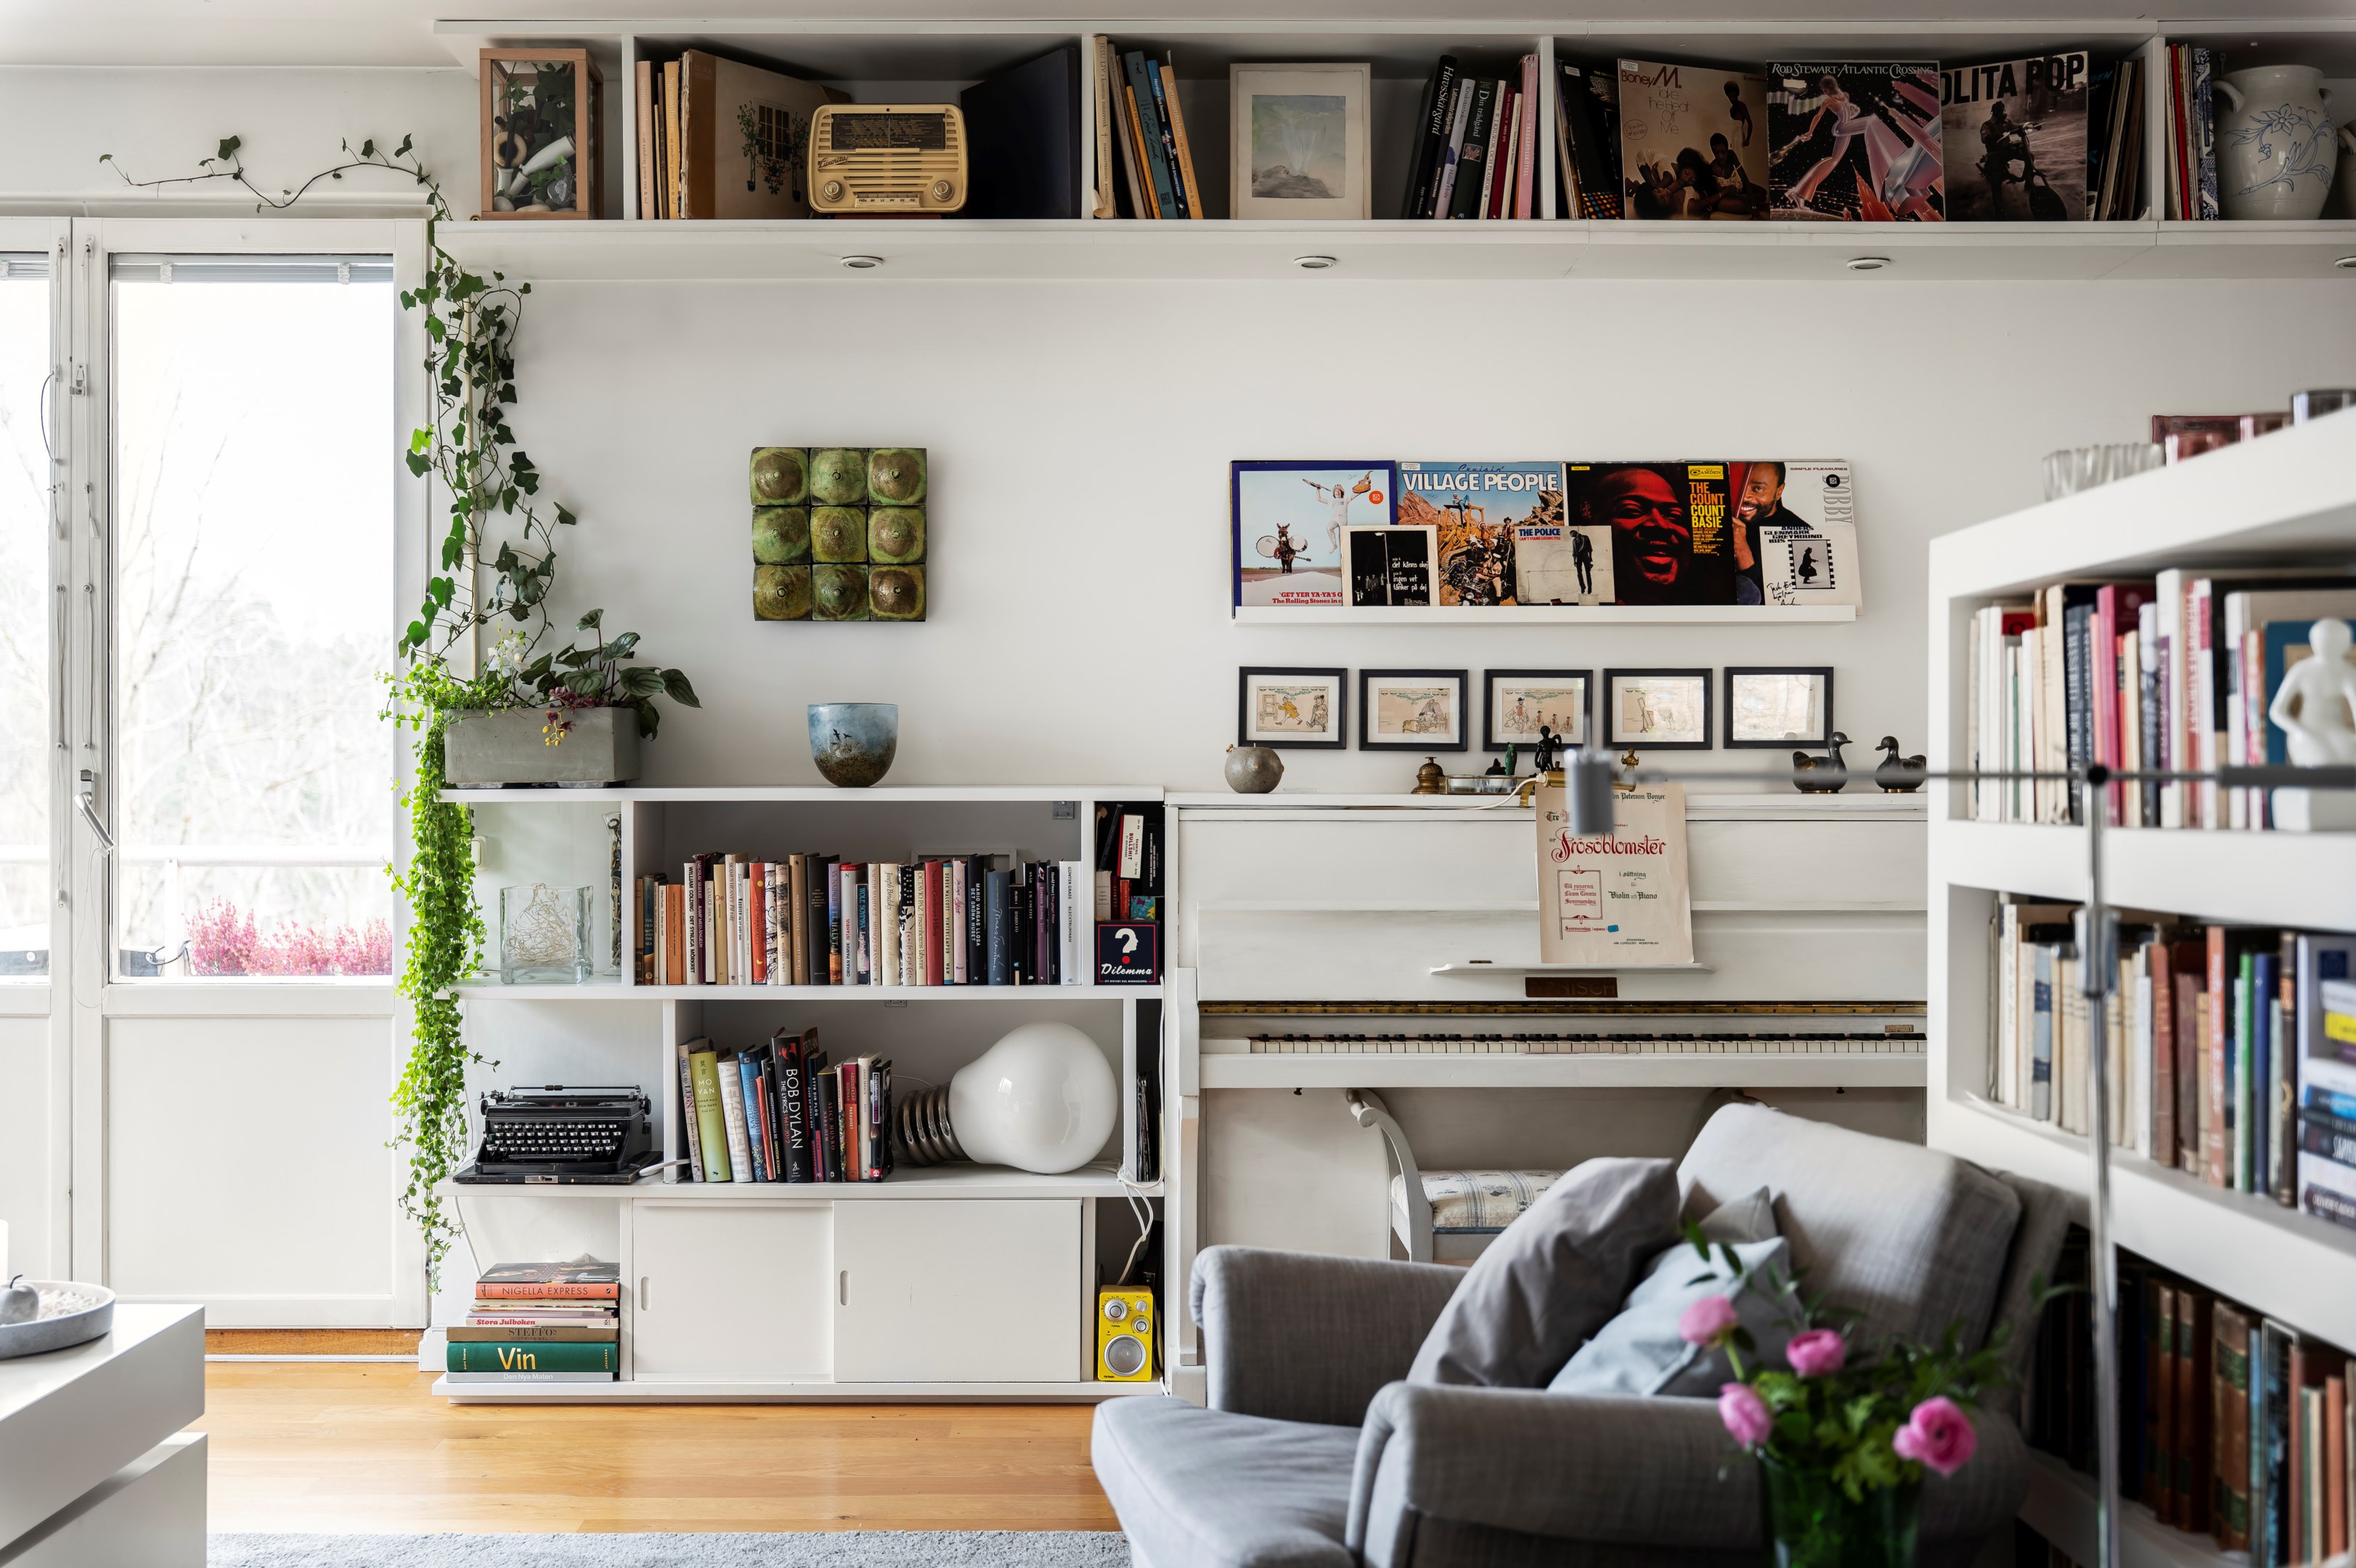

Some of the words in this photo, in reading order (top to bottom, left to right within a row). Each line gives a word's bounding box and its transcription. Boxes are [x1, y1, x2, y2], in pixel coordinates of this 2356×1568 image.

[1621, 70, 1655, 87] Boney
[1652, 66, 1682, 89] M.
[1889, 64, 1933, 78] CROSSING
[2026, 53, 2085, 94] POP
[1431, 65, 1455, 136] HavsSkärgård
[1478, 90, 1490, 106] Din
[1657, 86, 1679, 100] Take
[1443, 89, 1459, 134] Latmansträdgården
[1458, 86, 1471, 124] Krukväxtboken
[1647, 97, 1664, 110] The
[1666, 99, 1689, 113] Heat
[1472, 107, 1485, 138] trädgård
[1662, 110, 1676, 122] Off
[1660, 122, 1679, 134] Me
[1484, 166, 1493, 192] FLASKOR
[1403, 473, 1480, 491] VILLAGE
[1484, 473, 1558, 491] PEOPLE
[1689, 482, 1710, 494] THE
[1690, 494, 1725, 505] COUNT
[1822, 475, 1853, 524] BOBBY
[1690, 505, 1725, 517] COUNT
[1692, 516, 1723, 528] BASIE
[1419, 561, 1429, 571] okej
[1393, 575, 1407, 585] ingen
[1411, 584, 1417, 592] på
[1551, 827, 1667, 863] Frösöblomster
[884, 871, 893, 889] Joseph
[1623, 871, 1647, 881] sättning
[1636, 891, 1658, 901] Piano
[1101, 963, 1153, 975] Dilemma
[786, 1069, 800, 1098] BOB
[684, 1085, 693, 1108] LUGN
[752, 1099, 762, 1134] ISHIGURO
[788, 1102, 803, 1148] DYLAN
[497, 1347, 536, 1370] Vin
